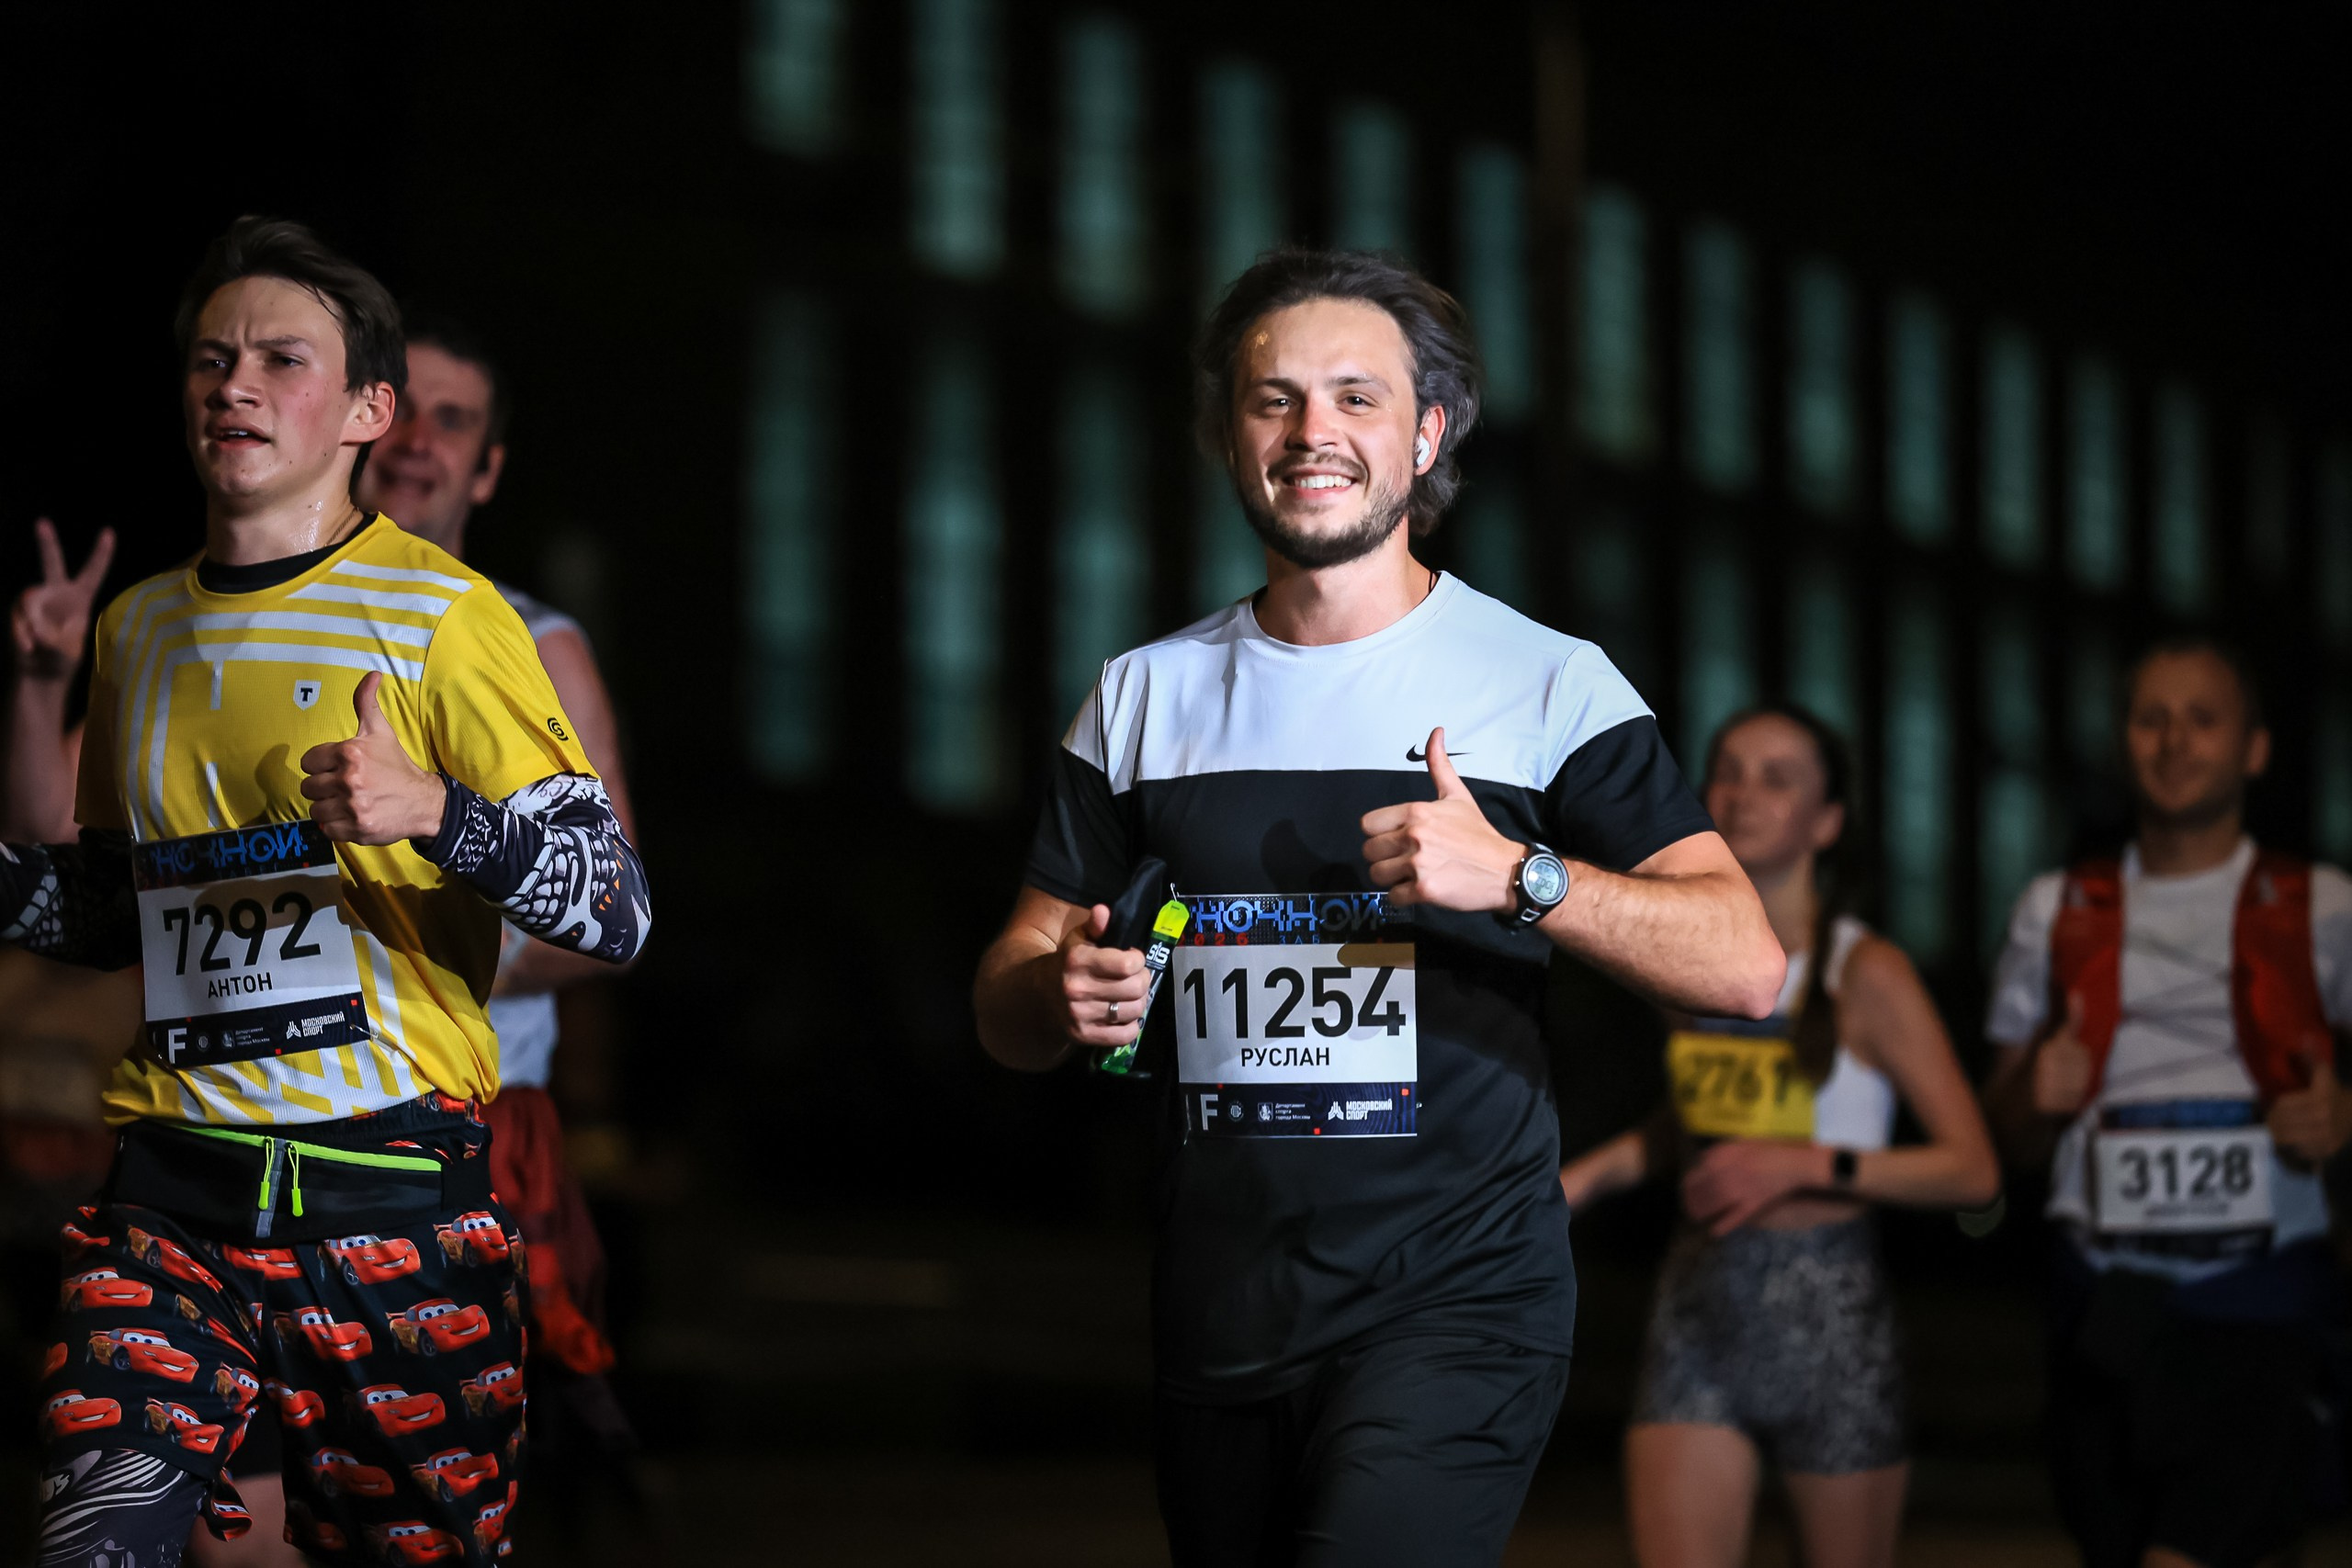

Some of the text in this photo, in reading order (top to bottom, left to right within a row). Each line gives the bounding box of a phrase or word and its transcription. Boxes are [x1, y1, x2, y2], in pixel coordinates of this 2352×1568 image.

[163, 891, 322, 976] 7292
[208, 972, 273, 998] АНТОН
[1183, 966, 1407, 1039] 11254
[300, 1010, 345, 1027] МОСКОВСКИЙ
[302, 1024, 323, 1037] СПОРТ
[168, 1028, 187, 1064] F
[1241, 1047, 1330, 1067] РУСЛАН
[1200, 1094, 1219, 1131] F
[1346, 1098, 1393, 1111] МОСКОВСКИЙ
[1346, 1110, 1369, 1121] СПОРТ
[2119, 1145, 2254, 1201] 3128
